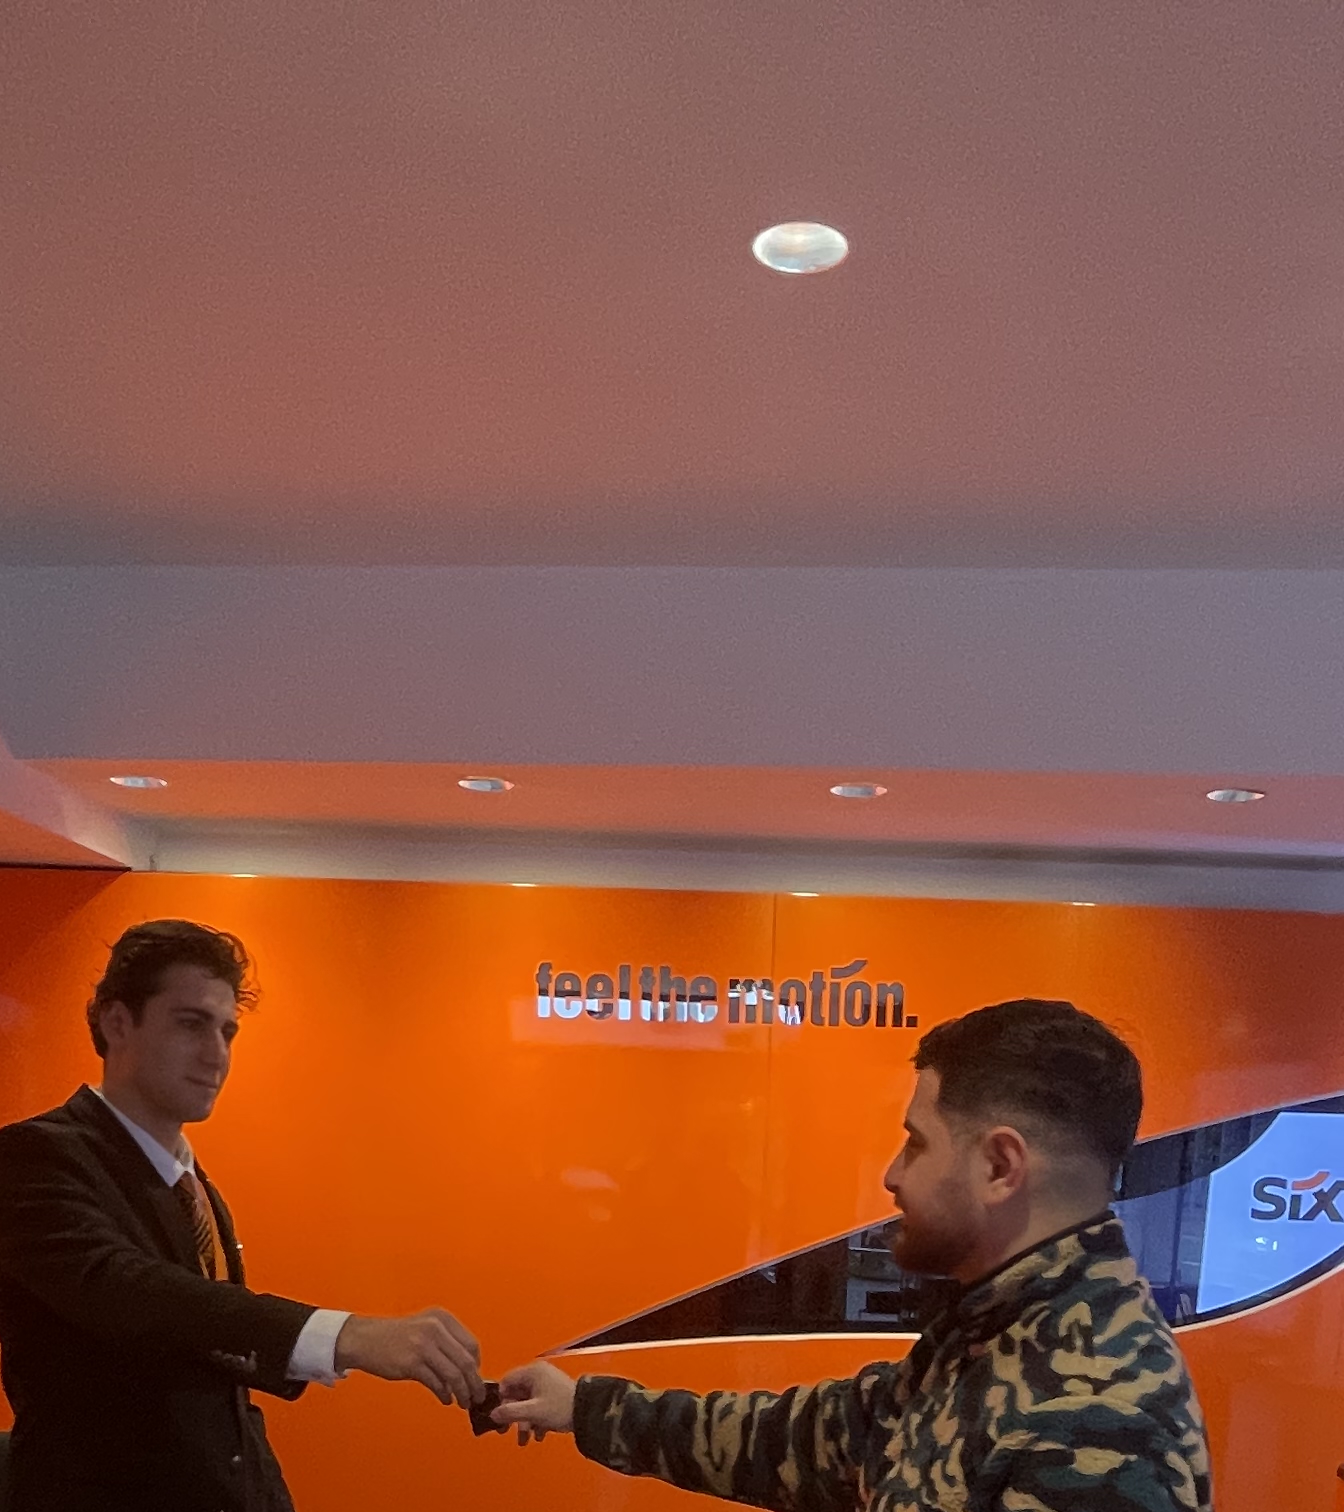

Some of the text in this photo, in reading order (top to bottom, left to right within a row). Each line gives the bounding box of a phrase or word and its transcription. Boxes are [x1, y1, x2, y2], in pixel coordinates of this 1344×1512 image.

[536, 959, 918, 1028] feel the motion.
